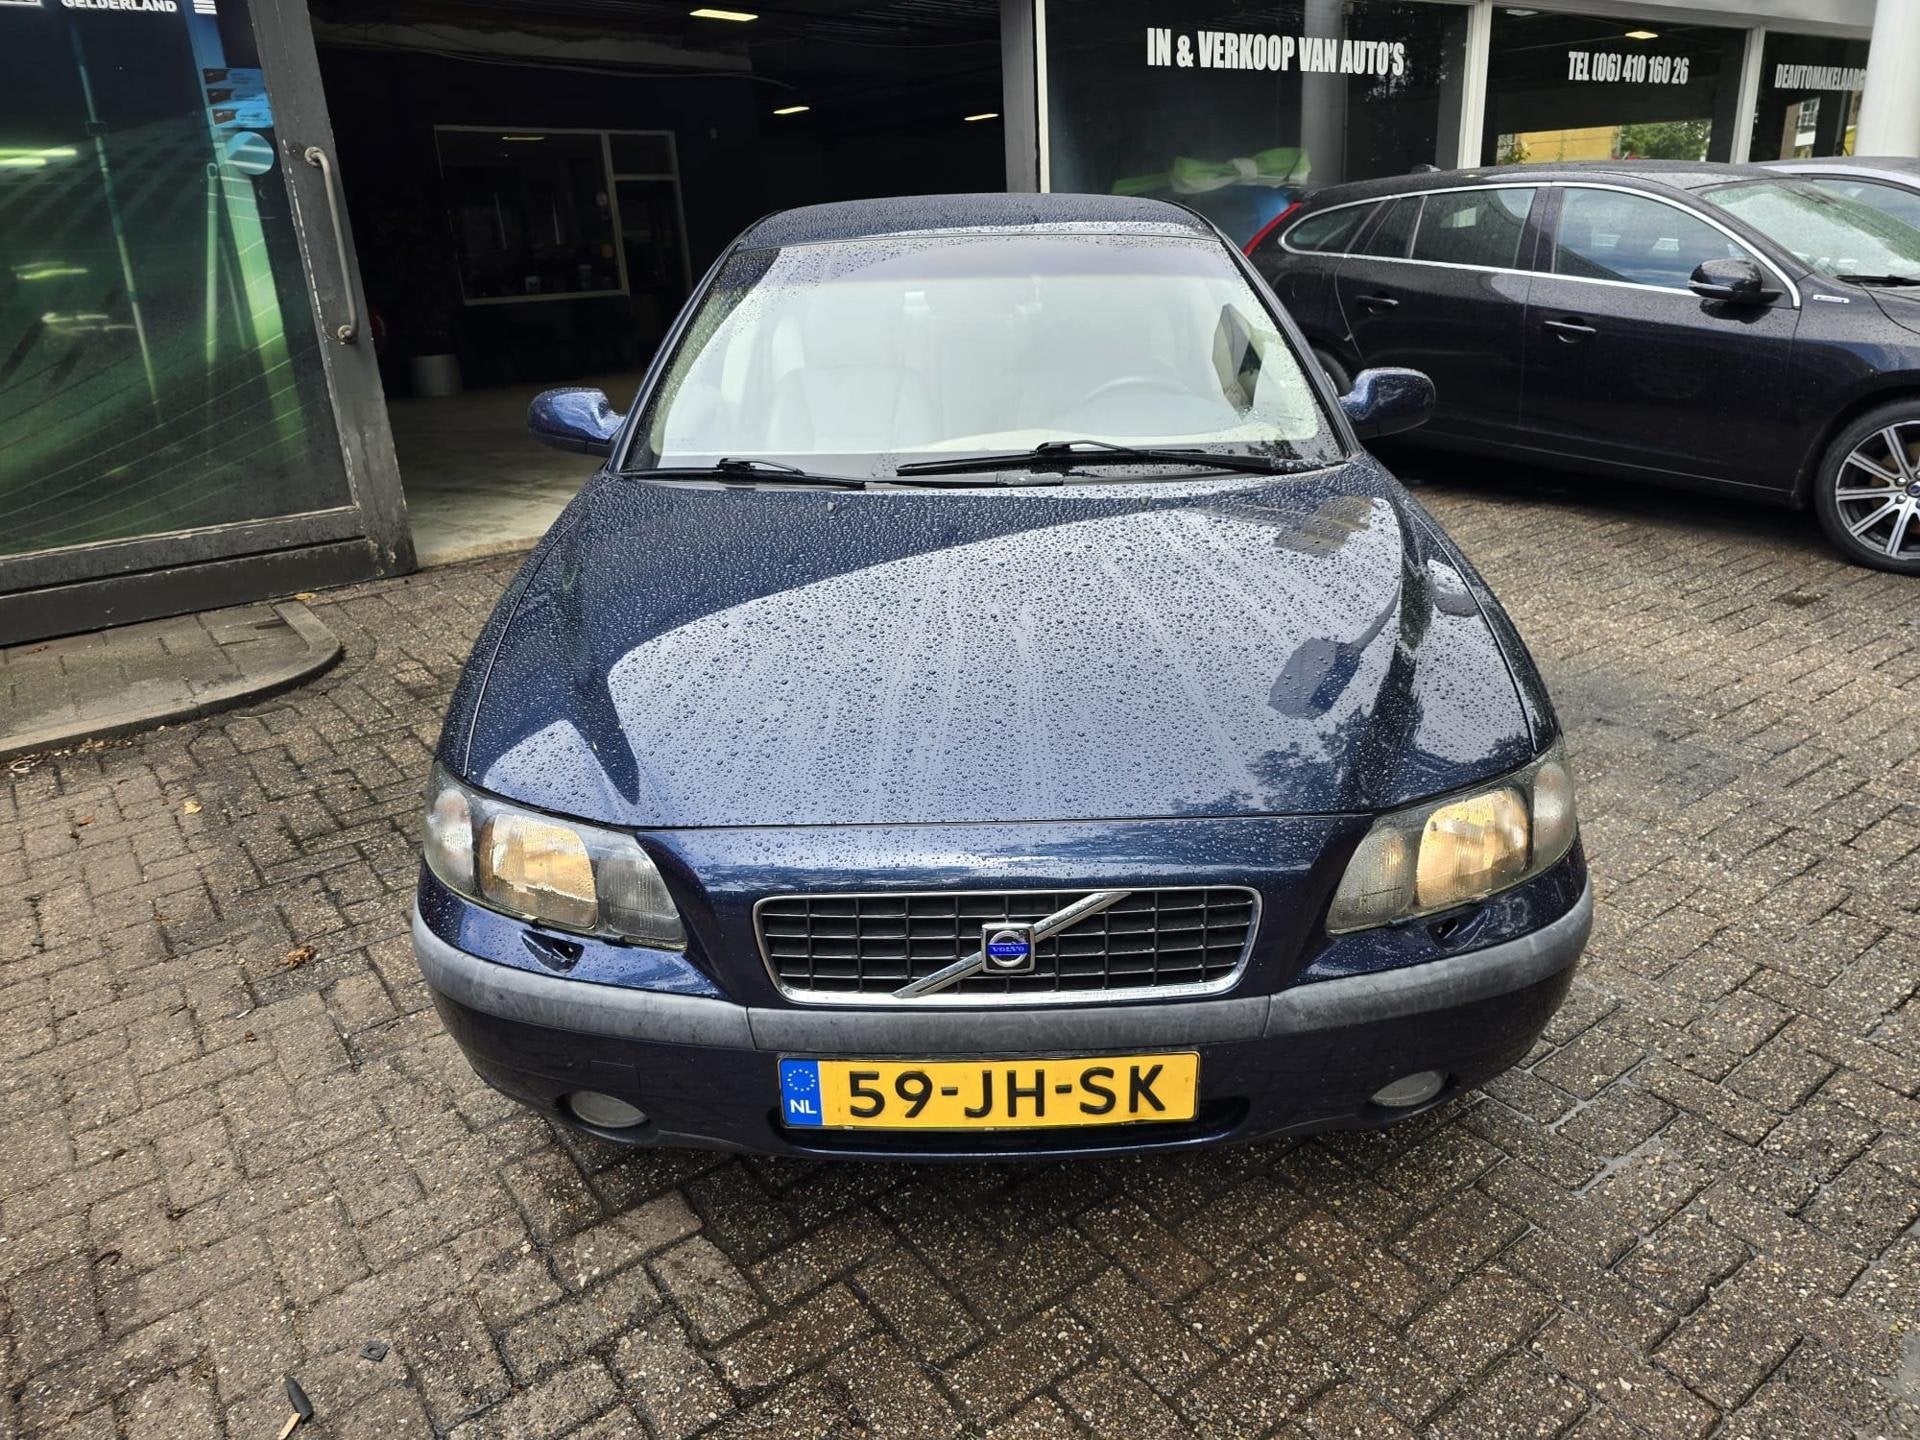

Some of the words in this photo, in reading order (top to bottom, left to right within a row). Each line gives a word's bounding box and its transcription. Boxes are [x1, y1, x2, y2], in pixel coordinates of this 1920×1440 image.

[61, 0, 178, 13] GELDERLAND
[1147, 28, 1171, 66] IN
[1177, 35, 1194, 67] &
[1198, 31, 1295, 71] VERKOOP
[1299, 37, 1337, 73] VAN
[1340, 40, 1405, 76] AUTO'S
[1568, 51, 1590, 81] TEL
[1592, 52, 1622, 82] (06)
[1622, 54, 1647, 83] 410
[1648, 55, 1671, 84] 160
[1671, 57, 1690, 85] 26
[790, 1098, 817, 1114] NL
[849, 1064, 1166, 1118] 59-JH-SK
